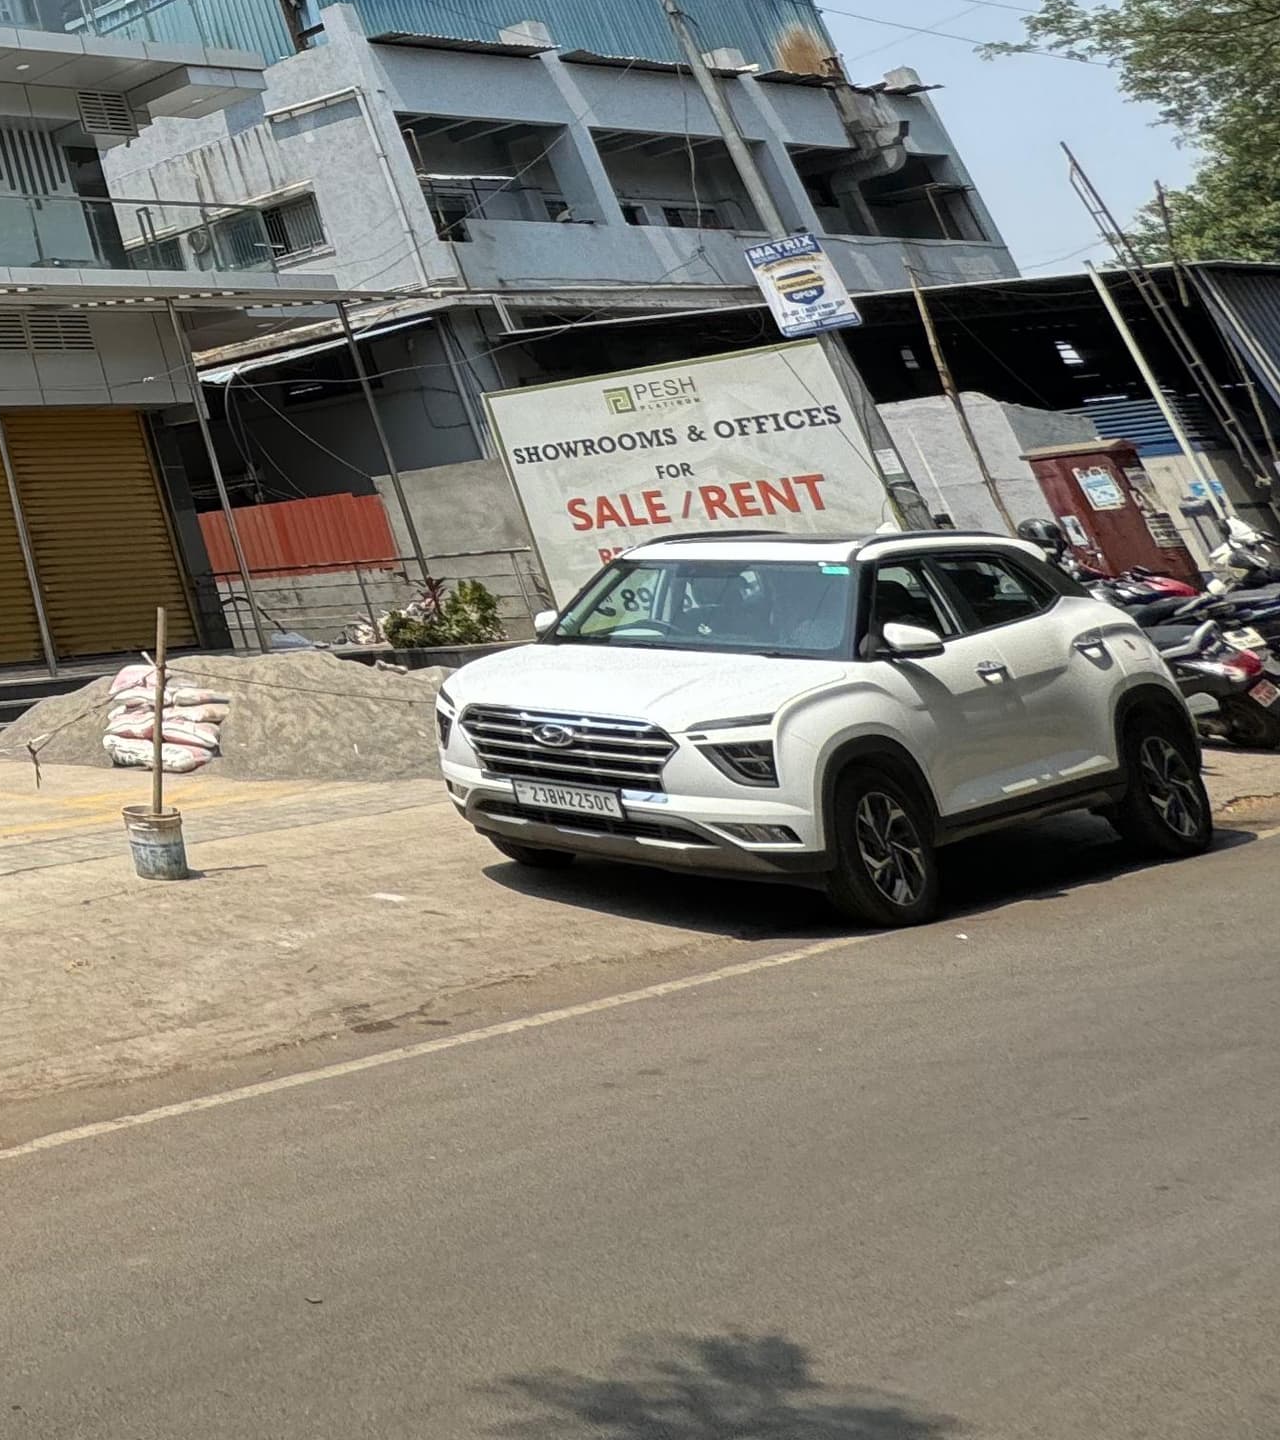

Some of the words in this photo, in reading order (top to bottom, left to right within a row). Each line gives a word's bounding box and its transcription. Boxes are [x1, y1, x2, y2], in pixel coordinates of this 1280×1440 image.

[748, 235, 814, 259] MATRIX
[633, 376, 697, 400] PESH
[640, 398, 701, 410] PLATINUM
[513, 427, 677, 465] SHOWROOMS
[687, 425, 707, 443] &
[713, 405, 842, 439] OFFICES
[655, 462, 695, 479] FOR
[567, 490, 673, 531] SALE
[698, 474, 826, 521] RENT
[529, 786, 614, 812] 23BH2250C
